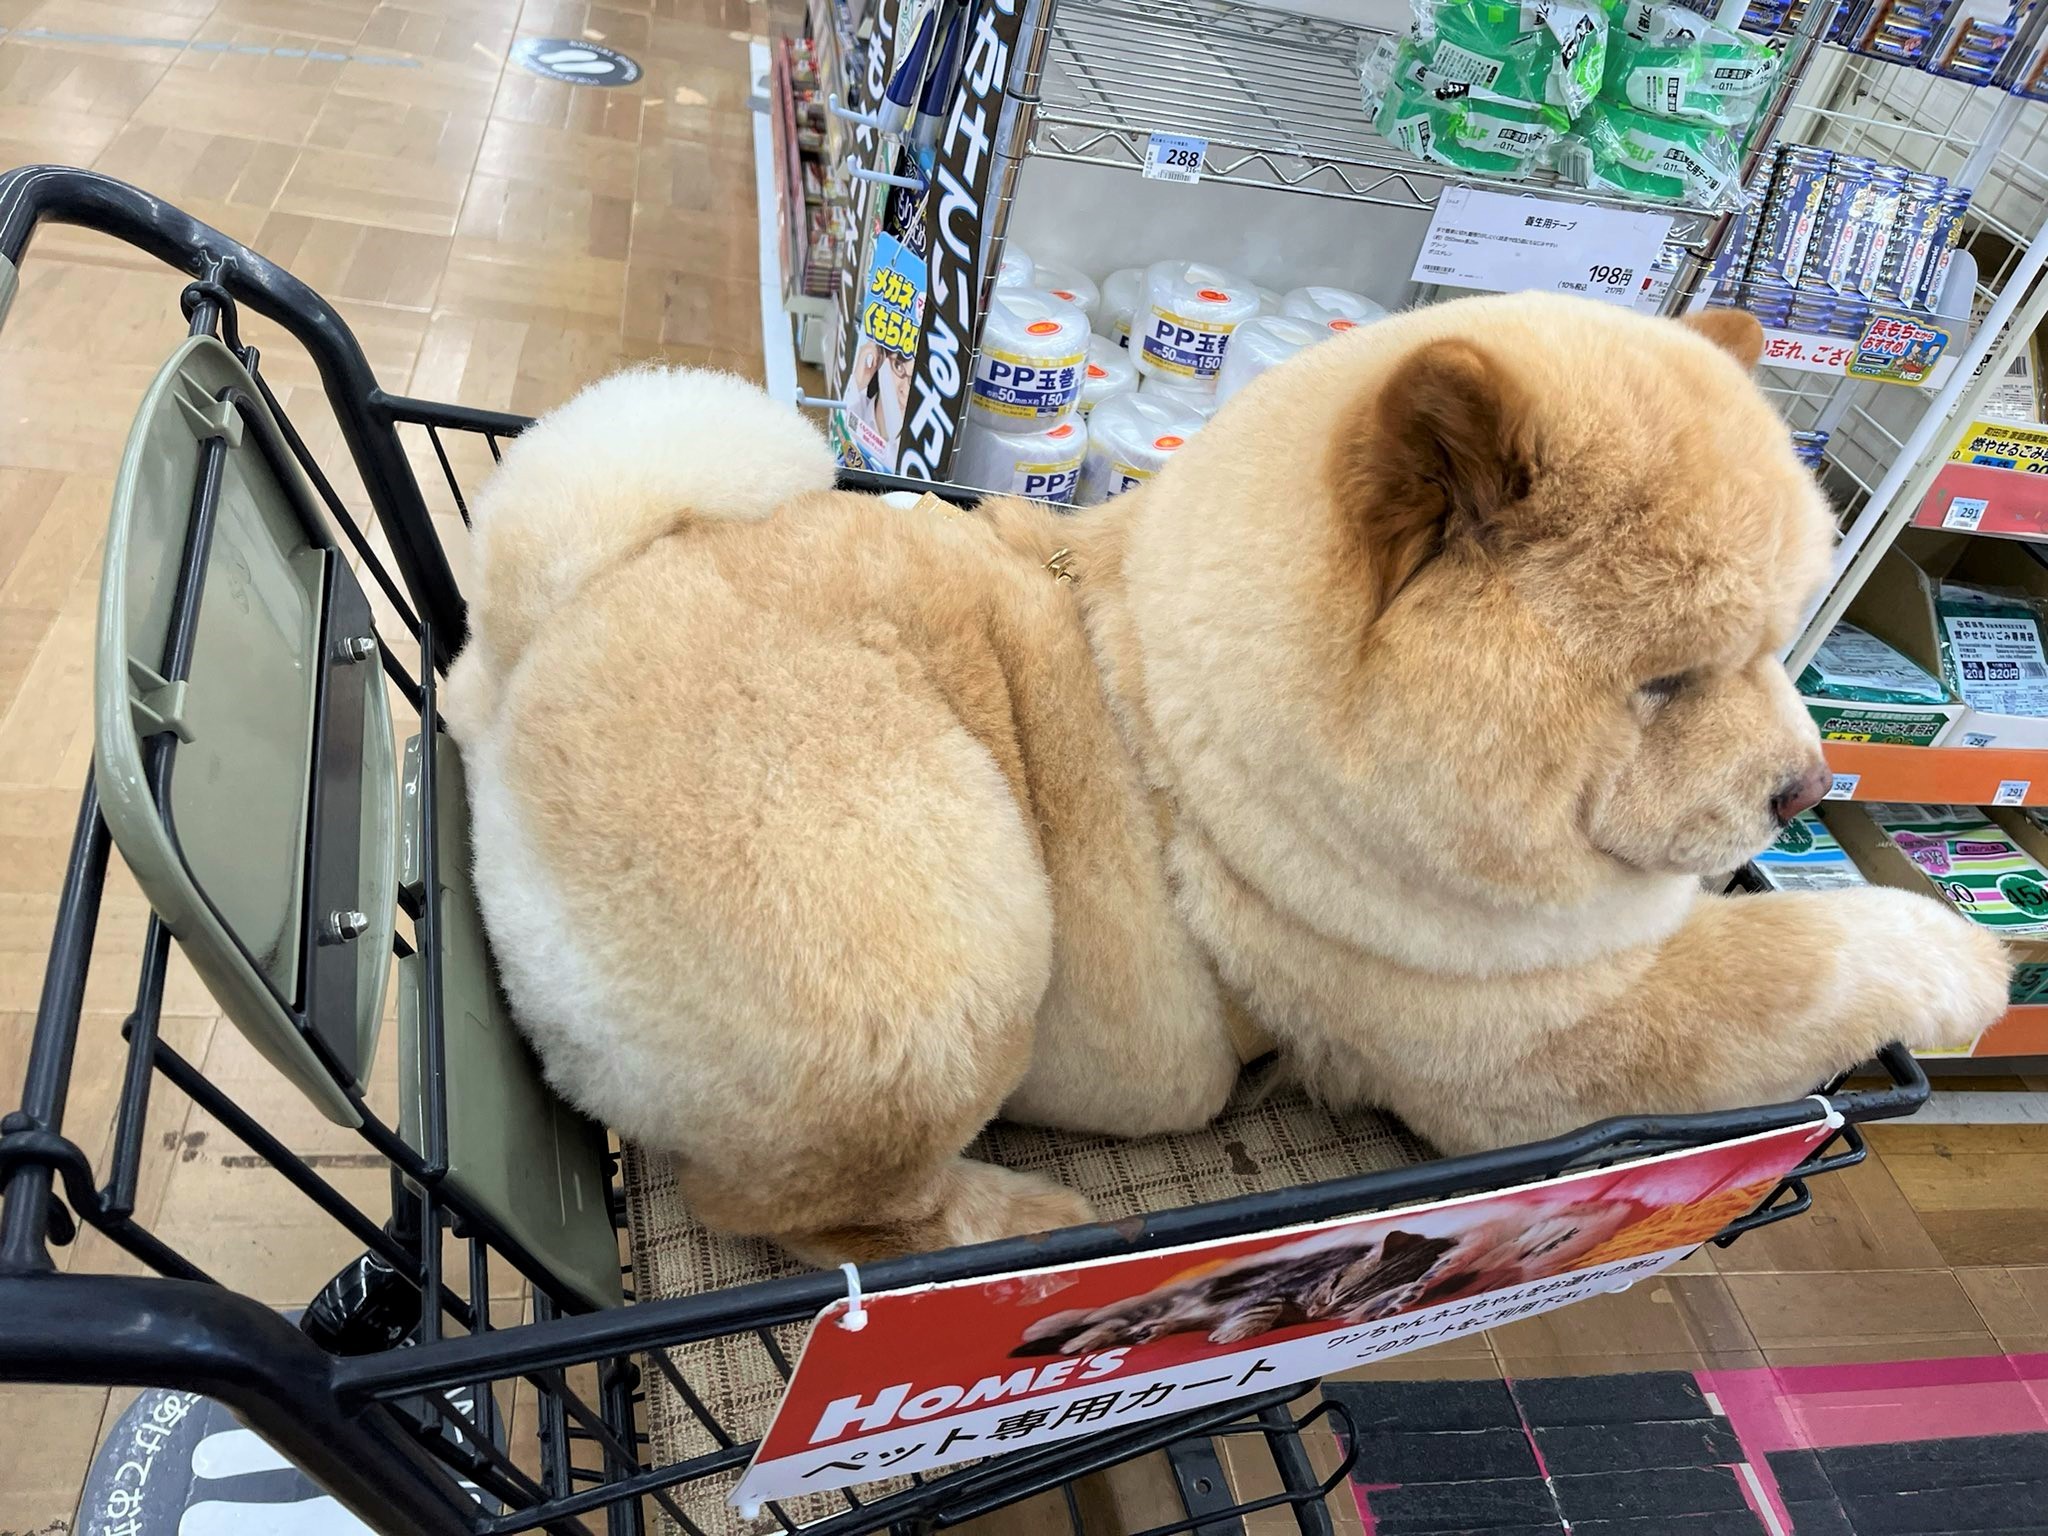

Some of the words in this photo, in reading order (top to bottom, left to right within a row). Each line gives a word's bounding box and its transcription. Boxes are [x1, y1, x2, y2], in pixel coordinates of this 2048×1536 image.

[1166, 148, 1199, 167] 288
[1524, 215, 1578, 231] 養生用テープ
[1777, 210, 1798, 261] Panasonic
[1823, 218, 1844, 267] Panasonic
[1895, 232, 1915, 284] Panasonic
[1920, 245, 1940, 292] Panasonic
[1588, 264, 1633, 287] 198円
[871, 266, 917, 312] メガネ
[1870, 319, 1934, 341] 長もちだから
[1862, 336, 1908, 355] おすすめ!
[989, 360, 1076, 391] PP玉巻
[1899, 371, 1923, 381] NEO
[1960, 507, 1980, 519] 291
[1989, 668, 2019, 679] 320円
[1833, 782, 1853, 791] 582
[2007, 788, 2023, 797] 291
[1357, 1287, 1594, 1359] このカートをご利用下さい
[807, 1346, 1133, 1446] HOME'S
[800, 1358, 1278, 1481] ペット専用カート
